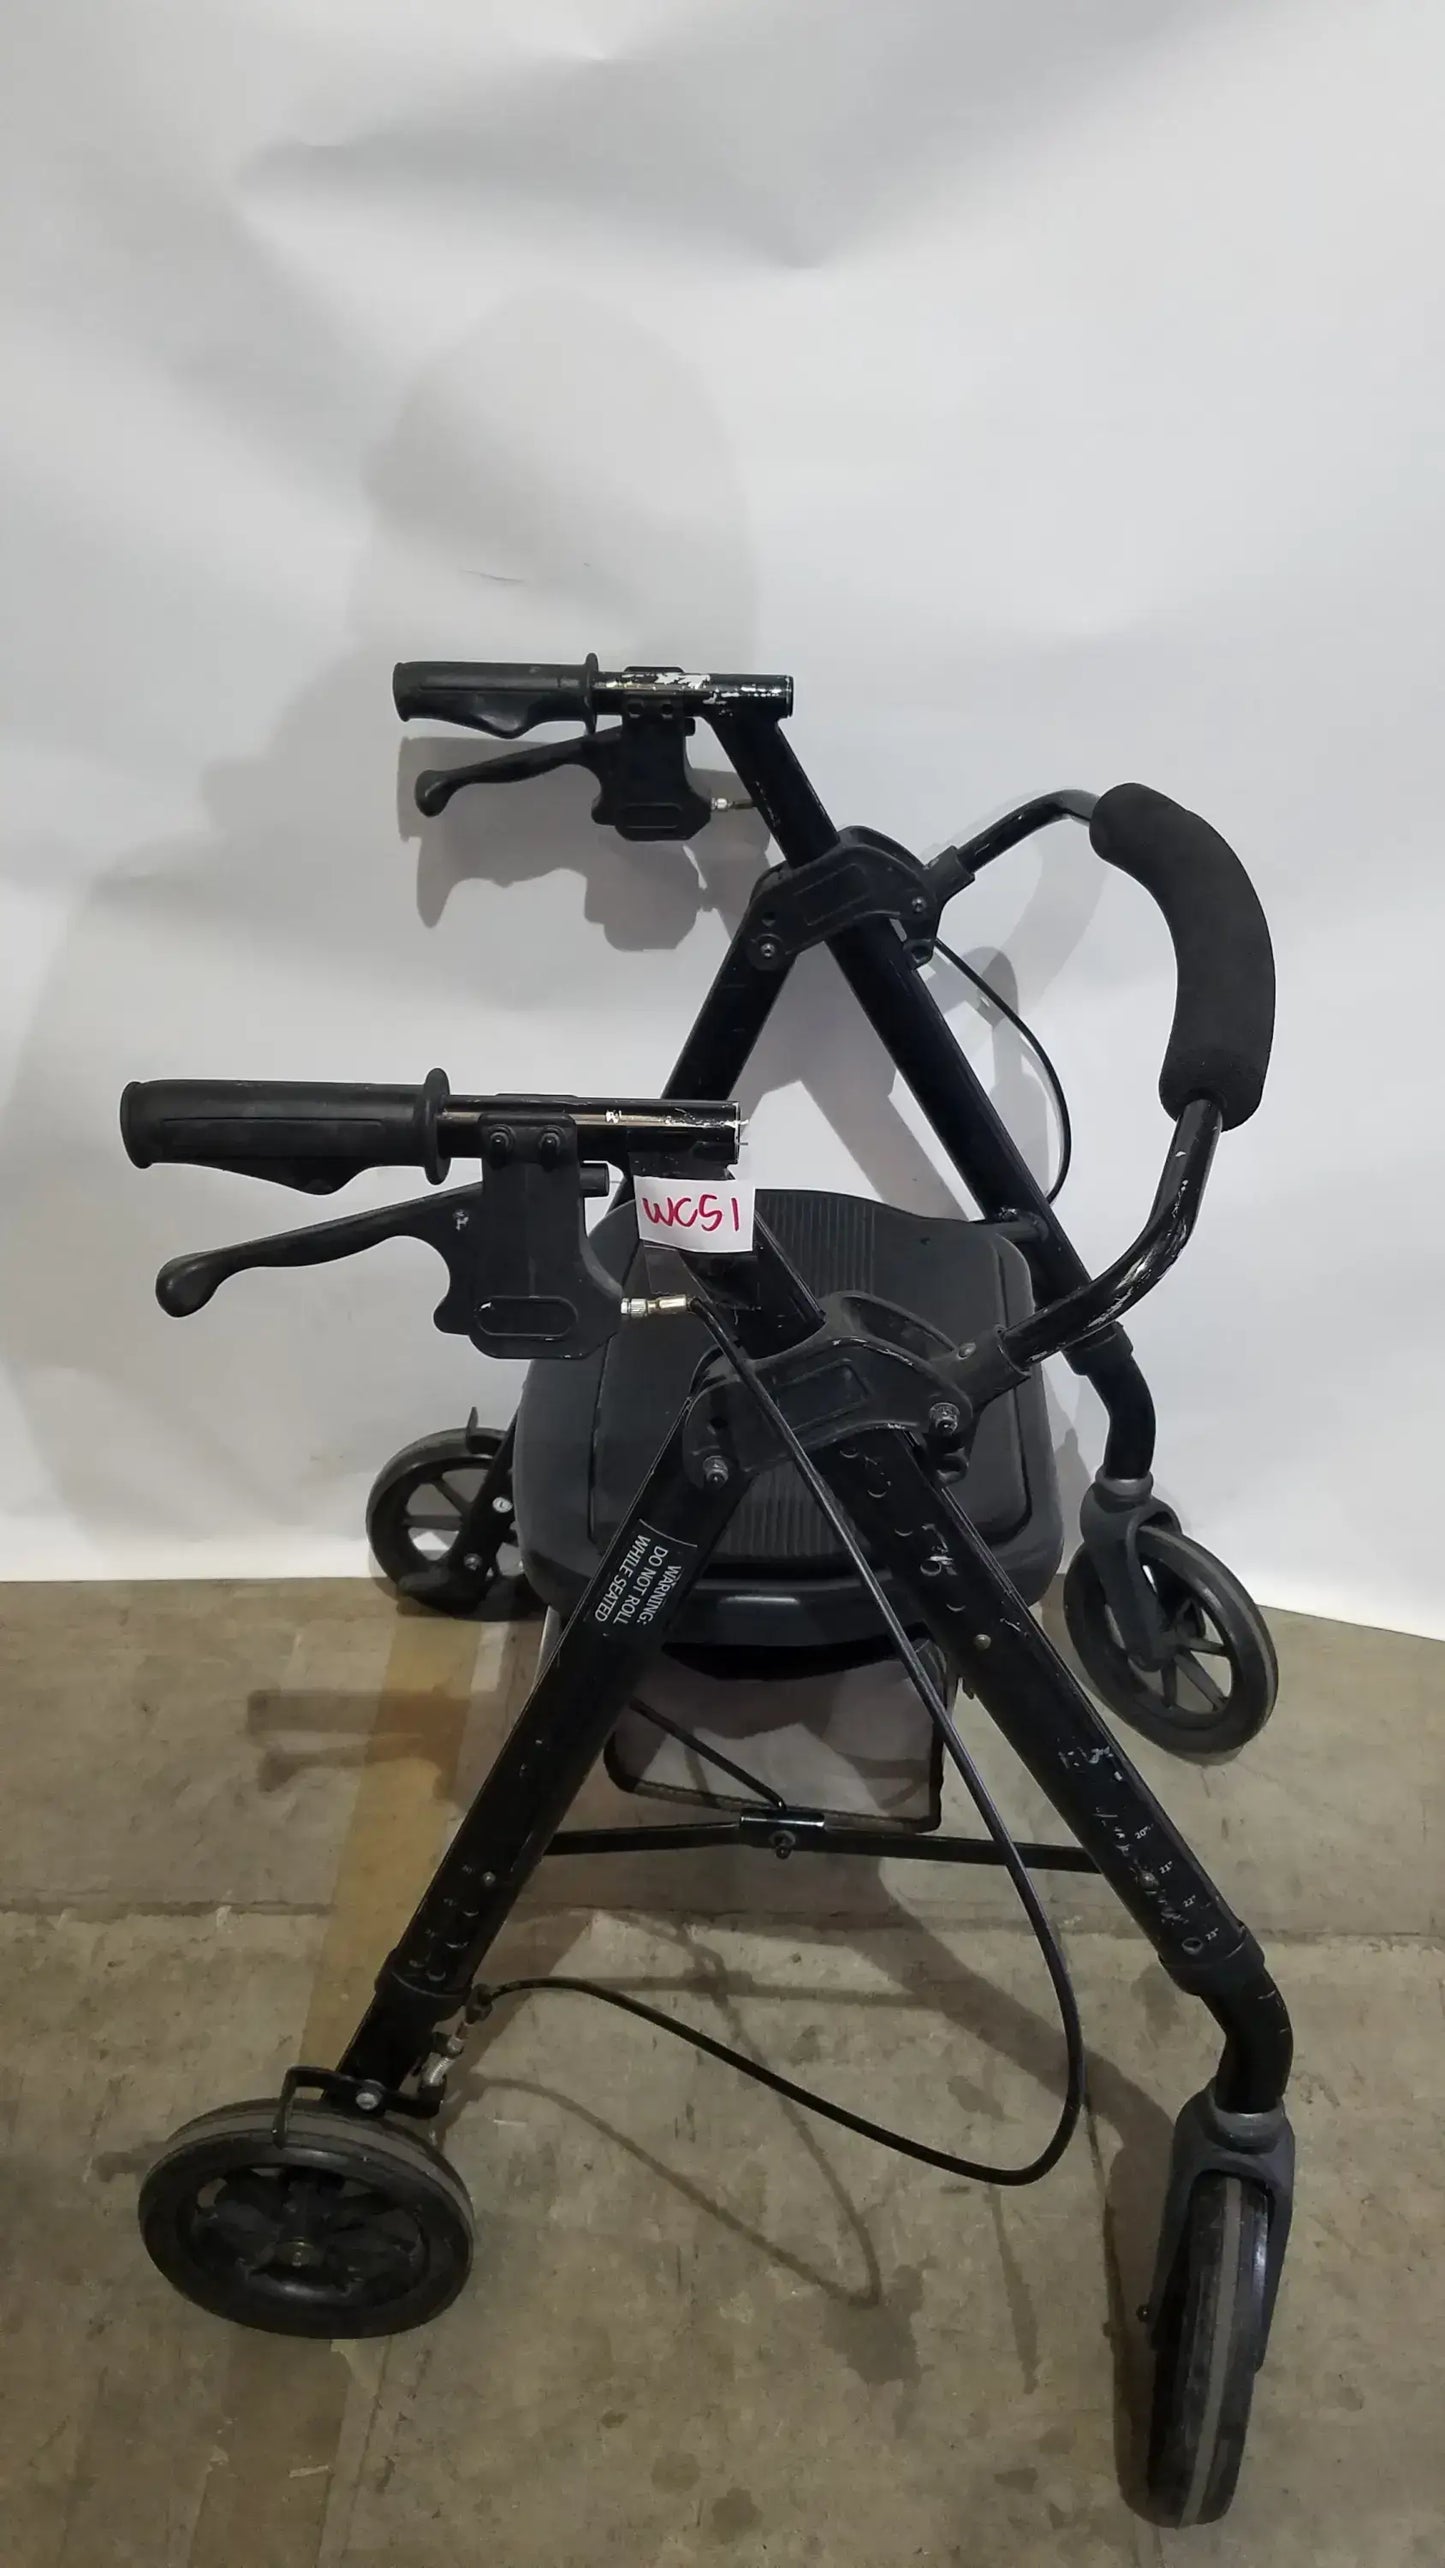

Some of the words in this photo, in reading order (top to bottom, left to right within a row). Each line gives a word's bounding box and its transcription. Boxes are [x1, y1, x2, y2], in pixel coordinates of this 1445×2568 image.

[642, 1194, 739, 1231] WC51
[619, 1534, 651, 1578] WHILE
[648, 1545, 669, 1567] DO
[594, 1575, 627, 1622] SEATED
[633, 1567, 657, 1596] NOT
[636, 1565, 682, 1625] WARNING:
[613, 1594, 641, 1624] ROLL
